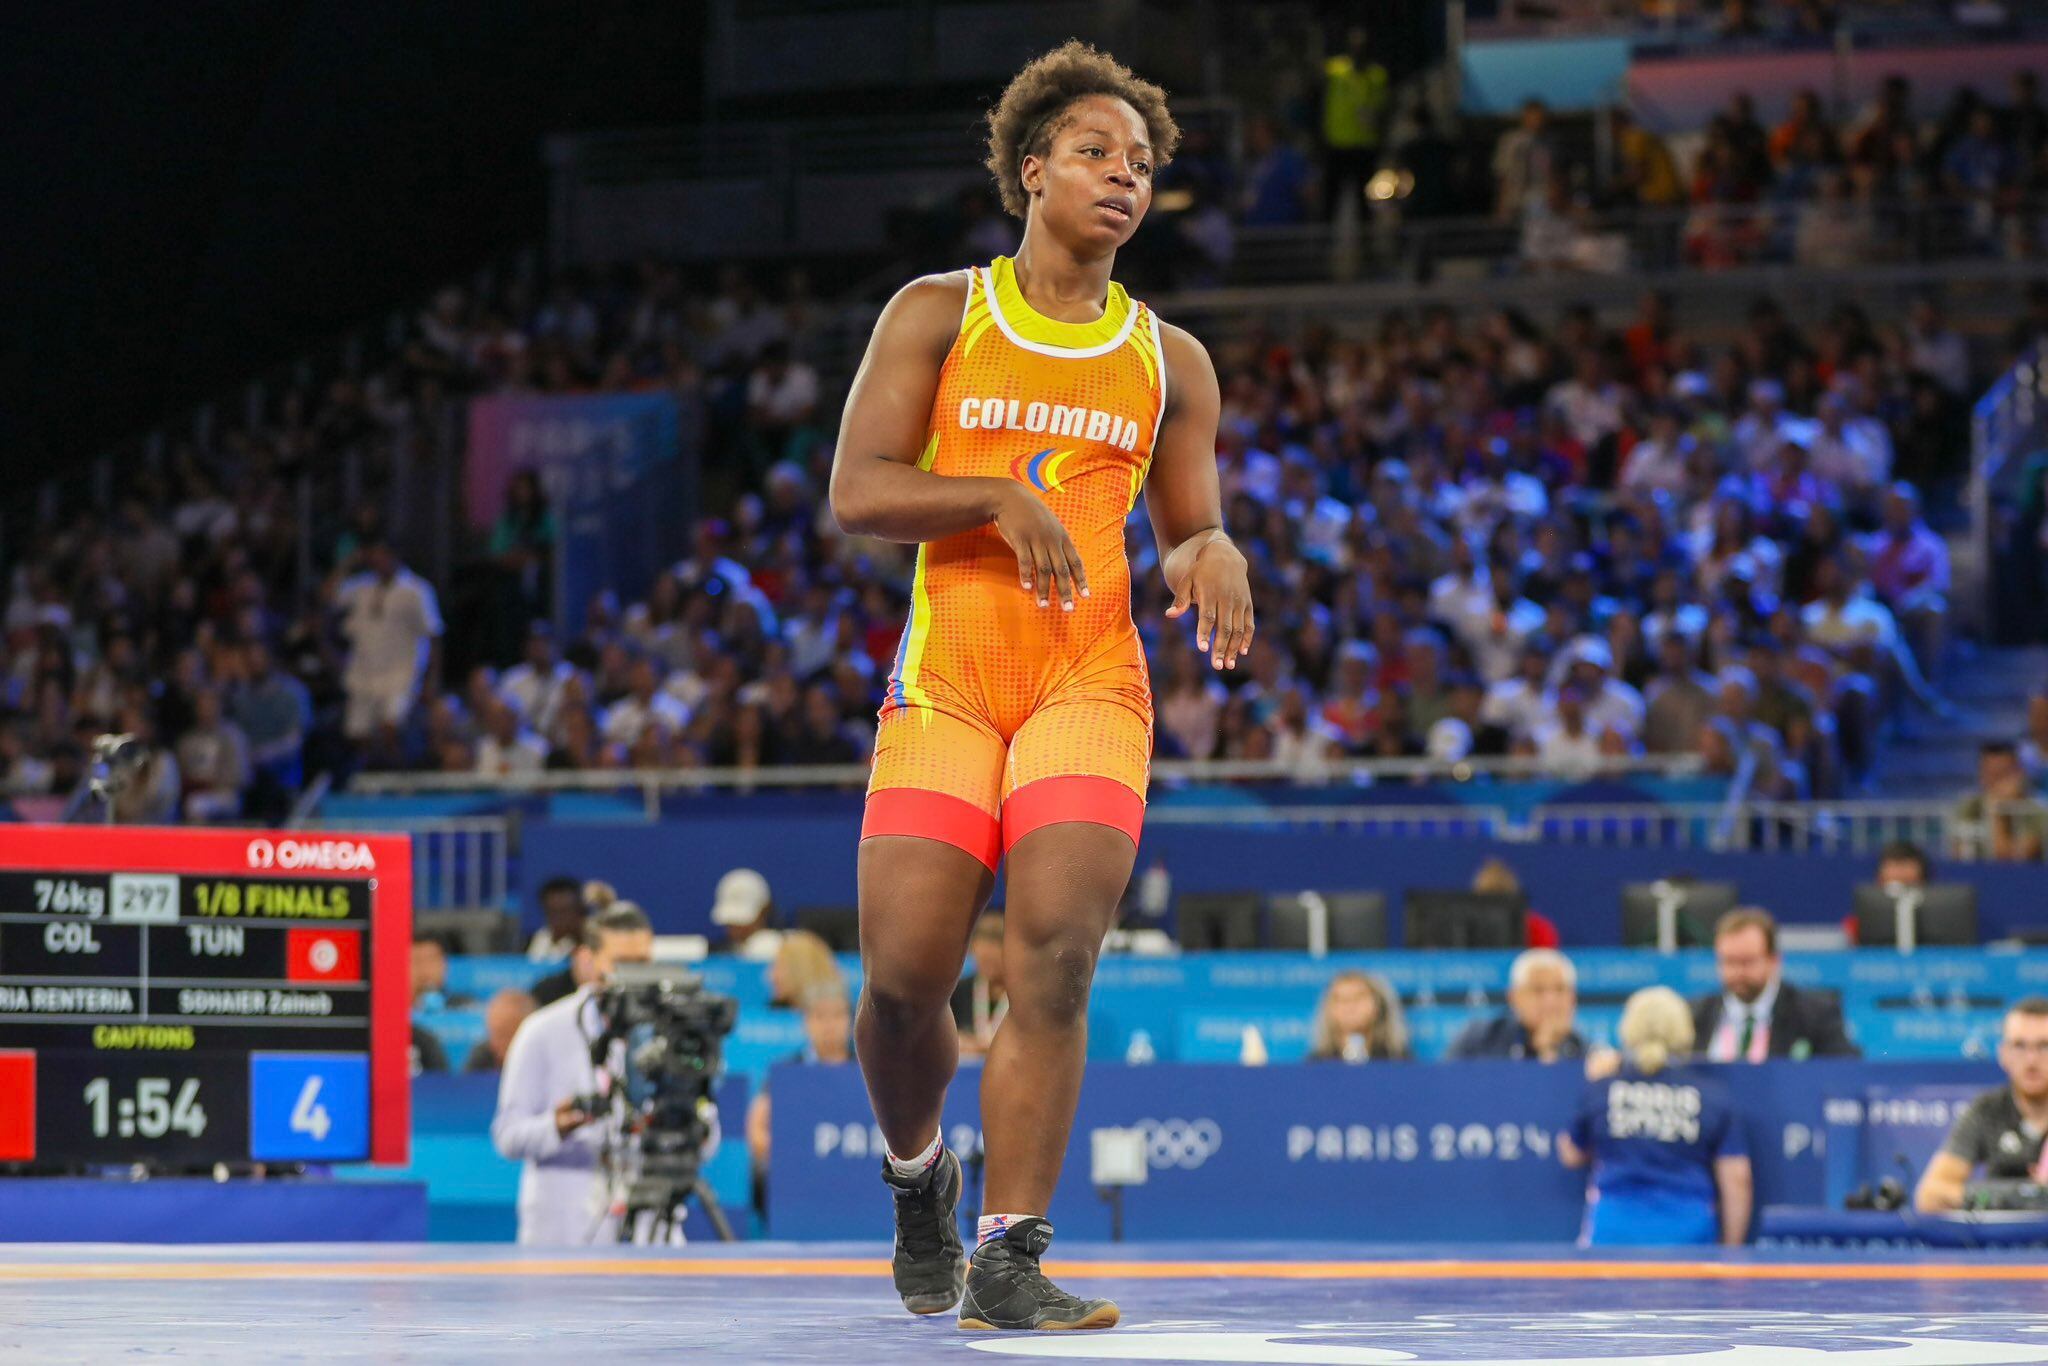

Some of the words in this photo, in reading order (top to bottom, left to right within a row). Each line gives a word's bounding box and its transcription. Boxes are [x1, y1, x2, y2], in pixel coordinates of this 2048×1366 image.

[959, 397, 1139, 452] COLOMBIA
[276, 842, 376, 870] OMEGA
[34, 879, 105, 919] 76kg
[122, 883, 171, 913] 297
[194, 882, 242, 917] 1/8
[245, 885, 350, 918] FINALS
[44, 922, 101, 953] COL
[186, 924, 245, 956] TUN
[31, 986, 134, 1014] RENTERIA
[93, 1024, 195, 1050] CAUTIONS
[83, 1077, 207, 1138] 1:54
[289, 1075, 331, 1141] 4
[1429, 1122, 1552, 1162] 2024
